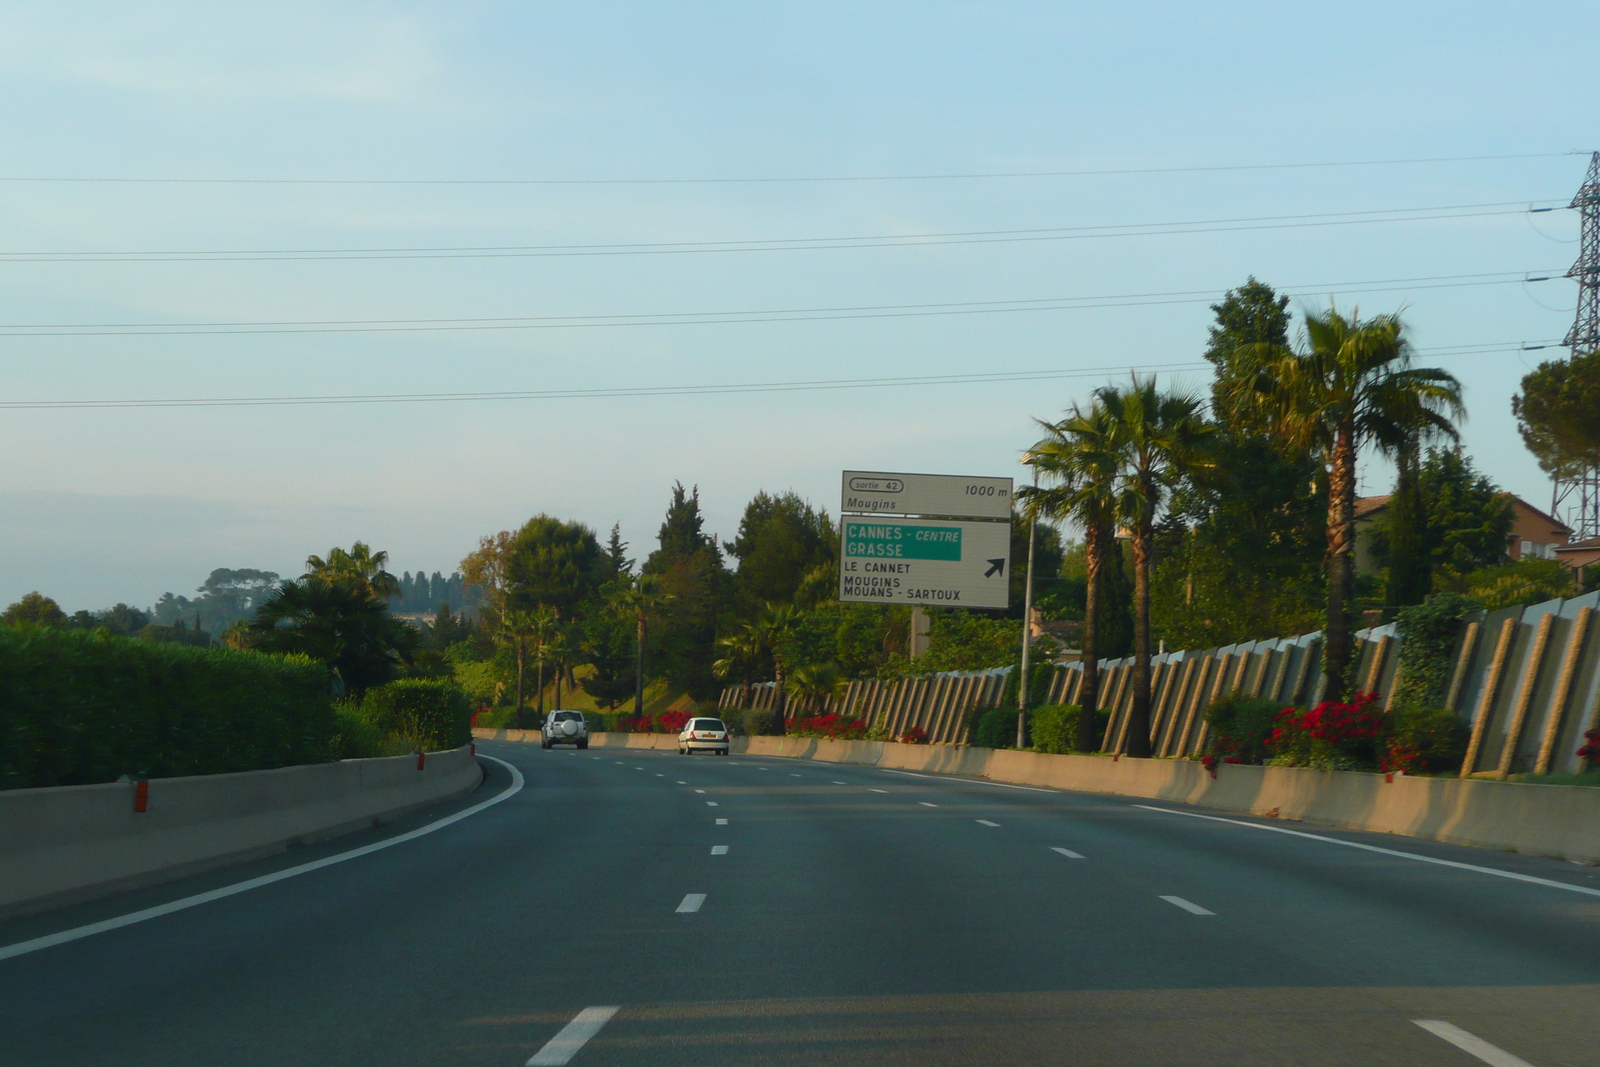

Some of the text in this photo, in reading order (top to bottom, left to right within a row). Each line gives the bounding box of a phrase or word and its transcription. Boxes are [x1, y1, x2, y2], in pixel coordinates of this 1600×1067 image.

[856, 481, 879, 489] sortie
[965, 486, 994, 496] 1000
[847, 498, 896, 510] Mougins
[849, 526, 902, 539] CANNES
[916, 530, 959, 542] CENTRE
[848, 542, 902, 556] GRASSE
[845, 562, 910, 573] LE CANNET
[844, 576, 900, 587] MOUGINS
[844, 587, 892, 597] MOUANS
[908, 589, 960, 600] SARTOUX
